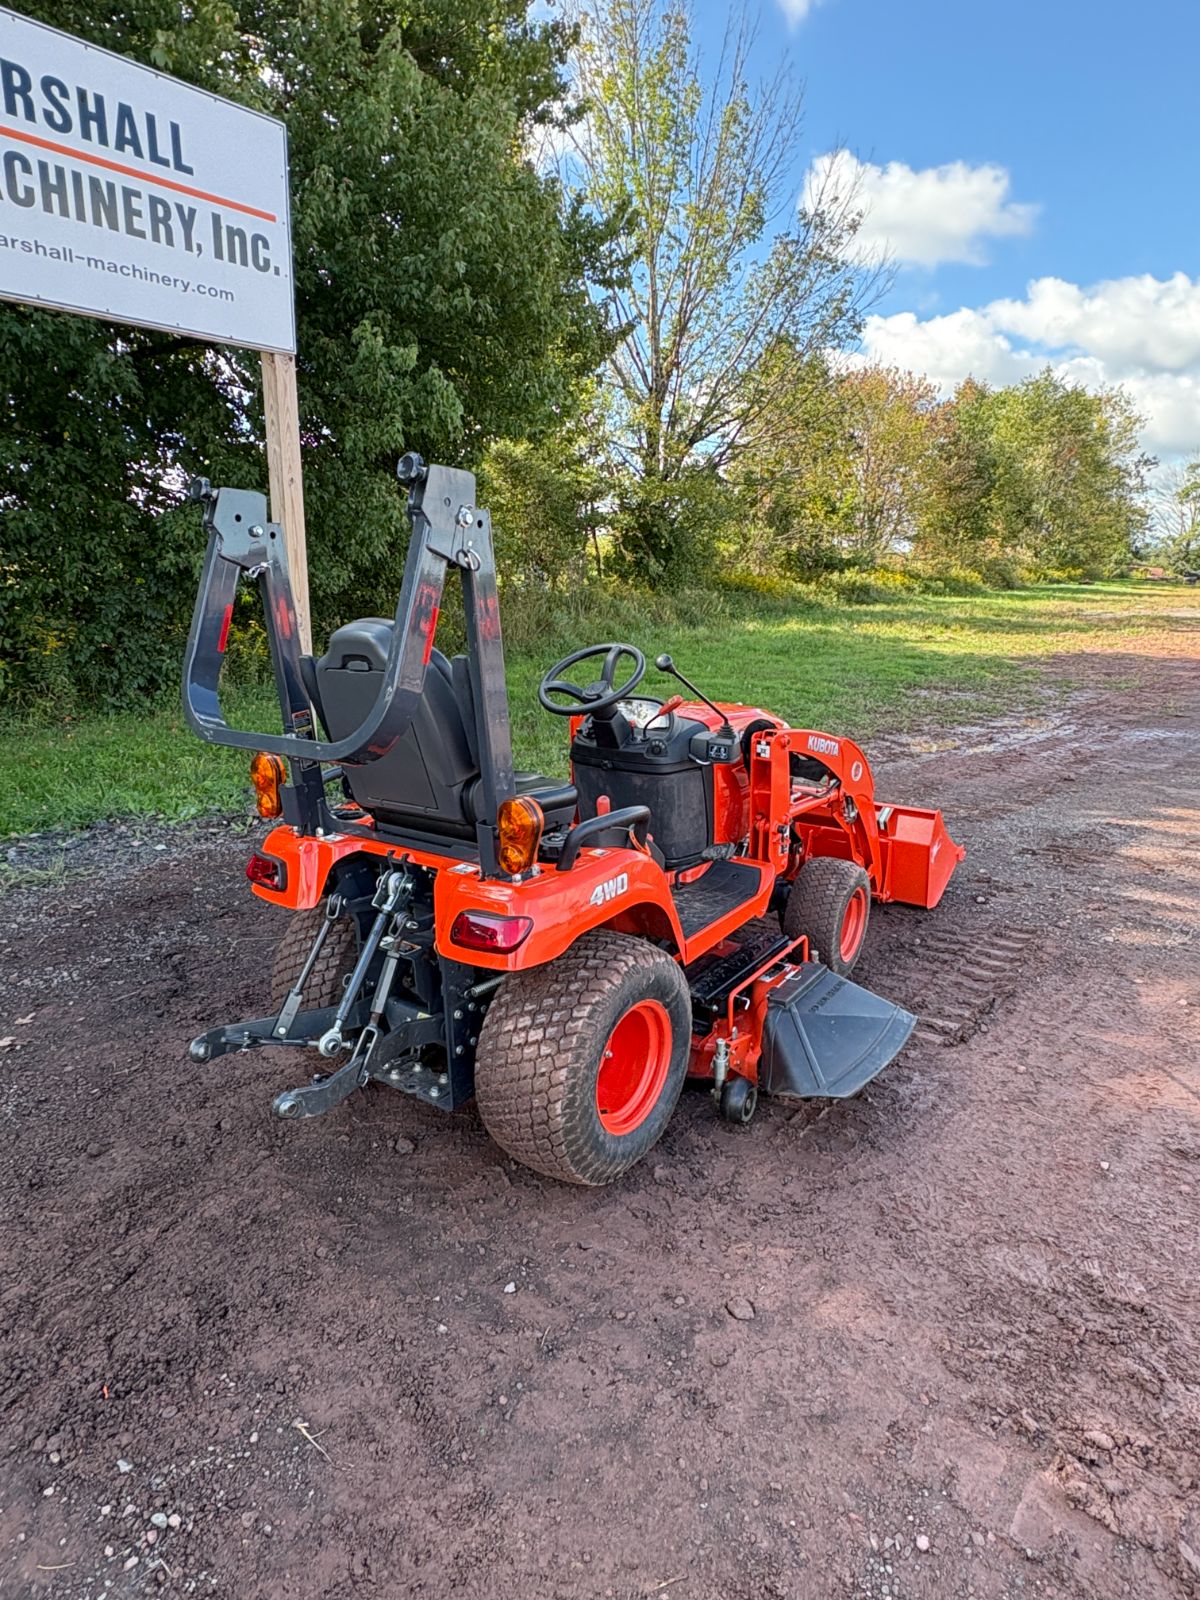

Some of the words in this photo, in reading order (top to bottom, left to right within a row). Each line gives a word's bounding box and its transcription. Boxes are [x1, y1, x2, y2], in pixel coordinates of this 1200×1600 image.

[0, 150, 203, 258] CHINERY,
[211, 211, 281, 277] Inc.
[807, 735, 839, 756] KUBOTA
[589, 872, 628, 906] 4WD
